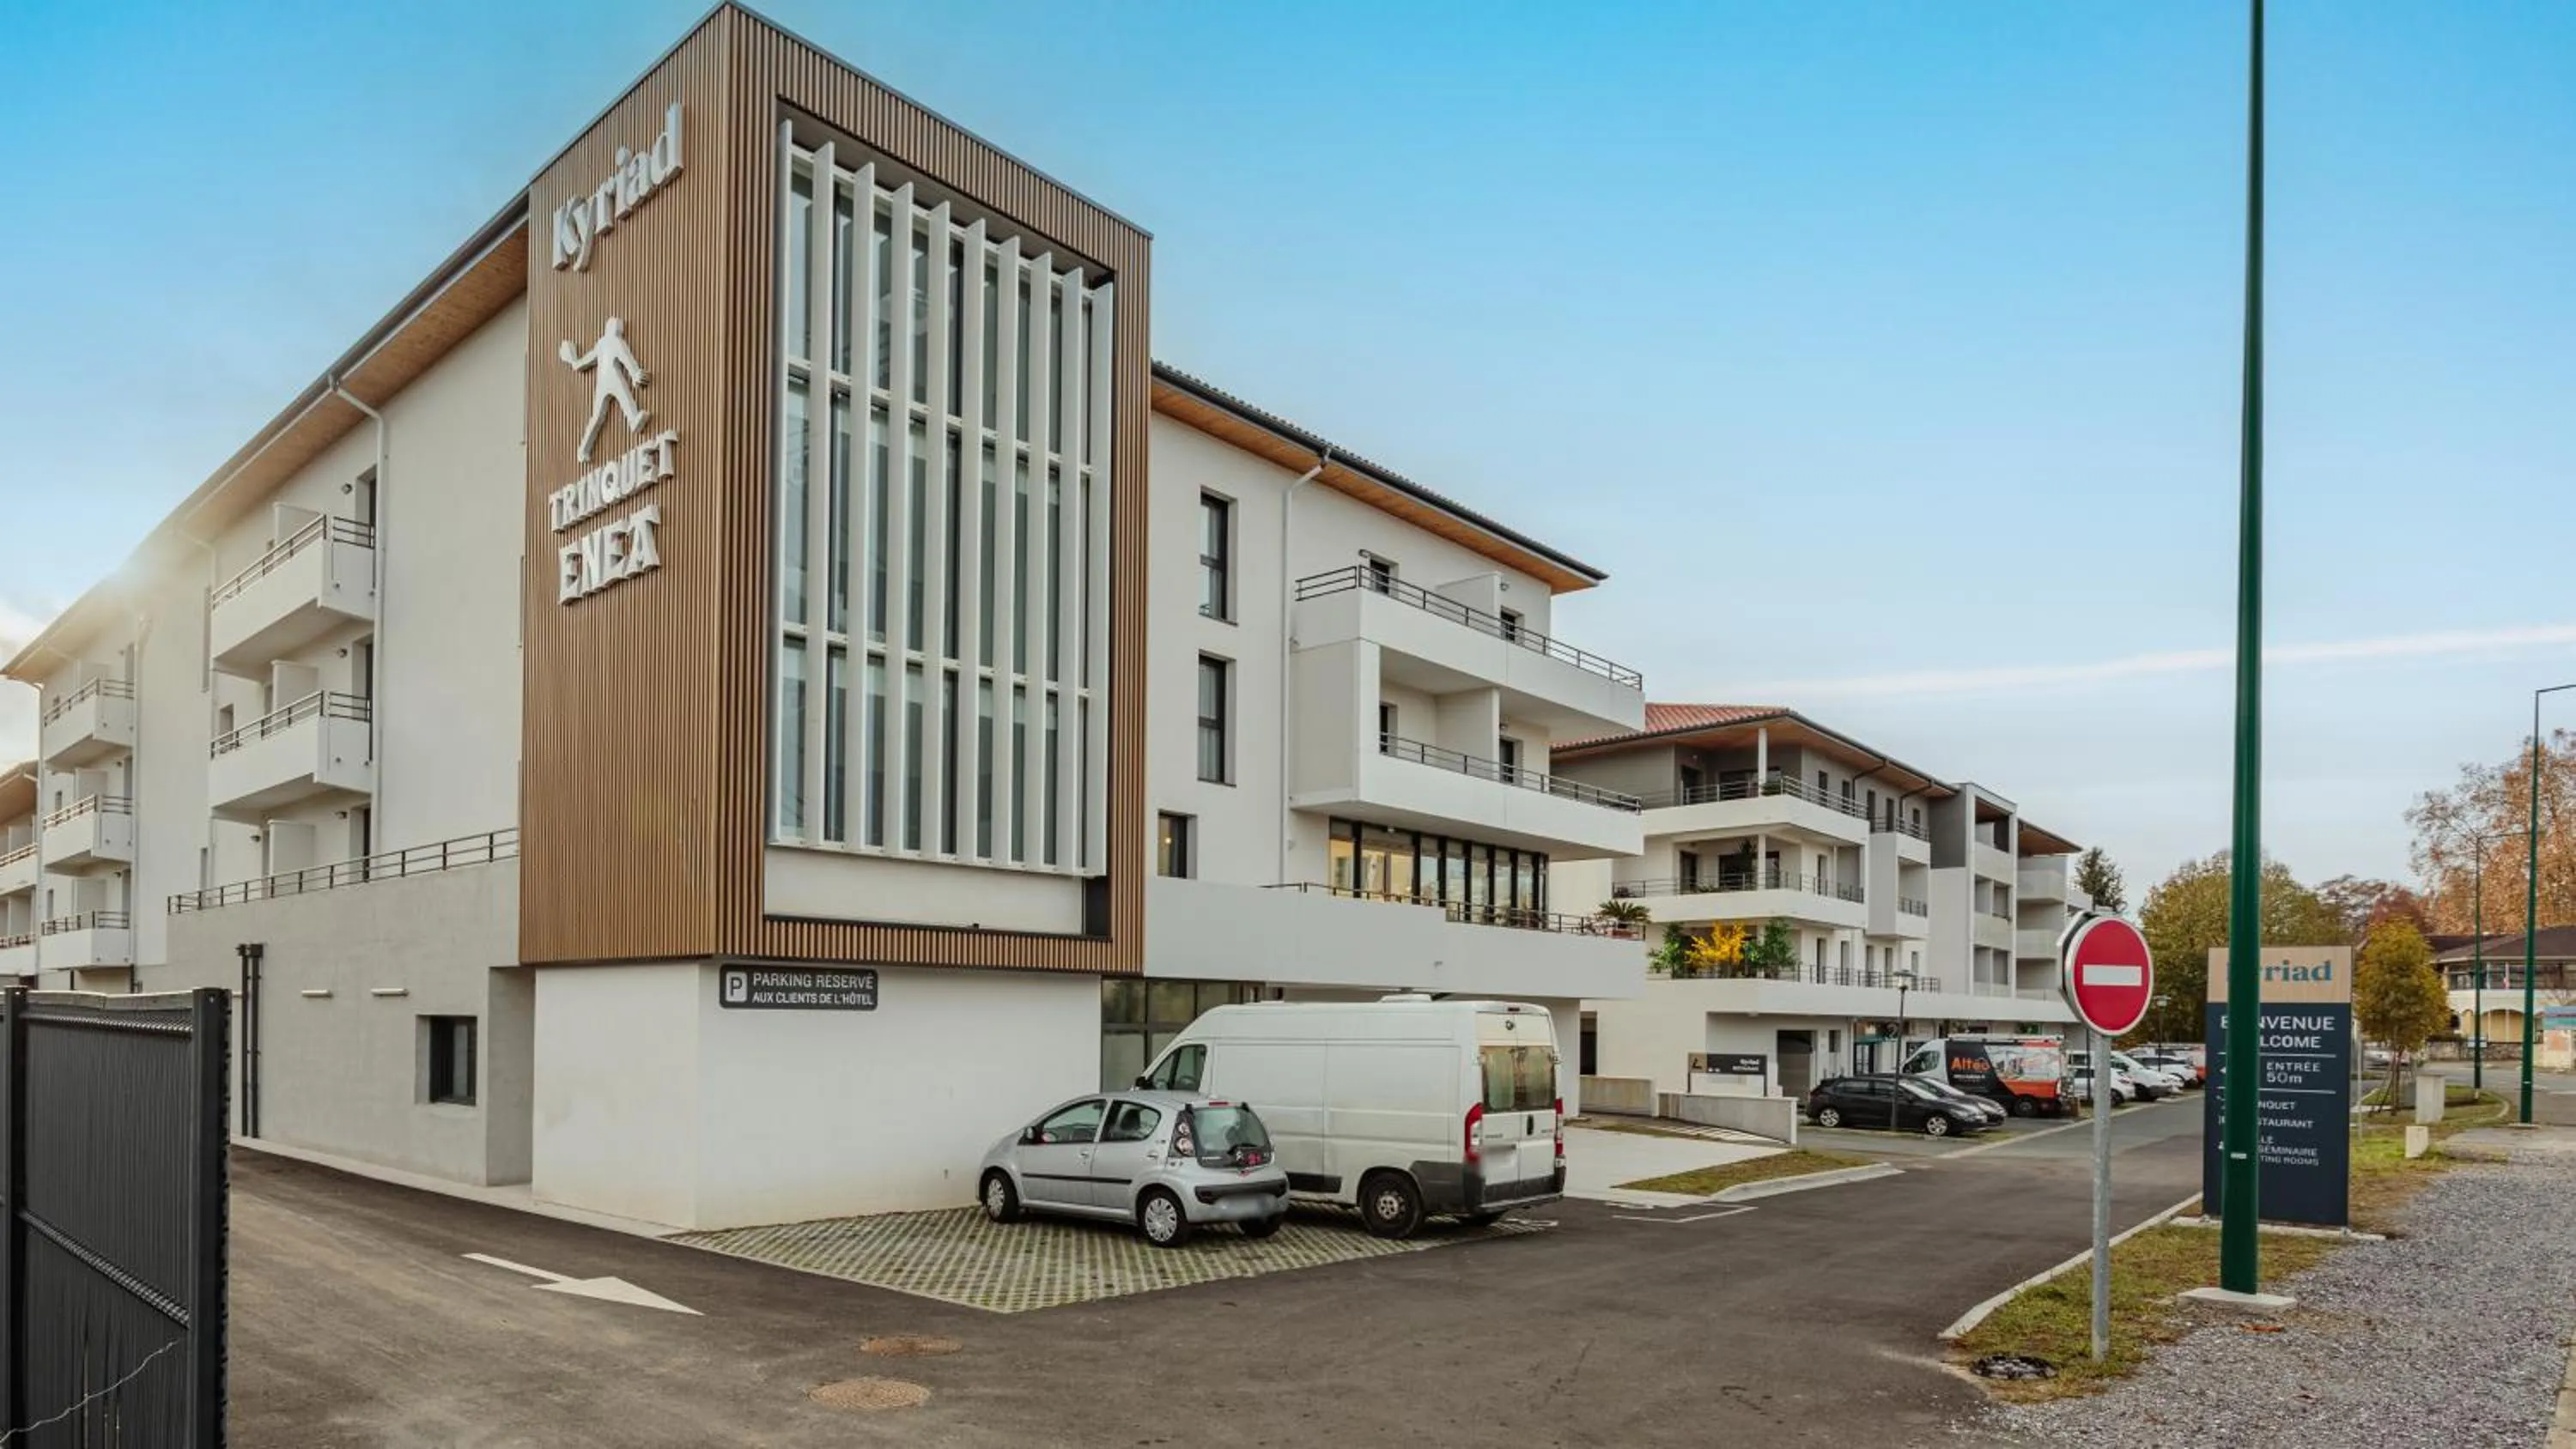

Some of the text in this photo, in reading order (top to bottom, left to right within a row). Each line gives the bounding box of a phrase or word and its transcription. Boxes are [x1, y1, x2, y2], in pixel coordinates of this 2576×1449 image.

[551, 102, 685, 273] Kyriad
[549, 429, 679, 534] TRINQUET
[2227, 959, 2333, 982] riad
[730, 976, 743, 997] P
[752, 972, 812, 987] PARKING
[751, 991, 774, 1003] AUX
[775, 991, 817, 1004] CLIENTS
[819, 993, 832, 1004] DE
[2221, 1016, 2336, 1031] BNVENUE
[2258, 1034, 2322, 1048] LCOME
[2266, 1072, 2303, 1083] 50m
[2257, 1100, 2295, 1110] NQUET
[2257, 1117, 2314, 1129] TAURANT
